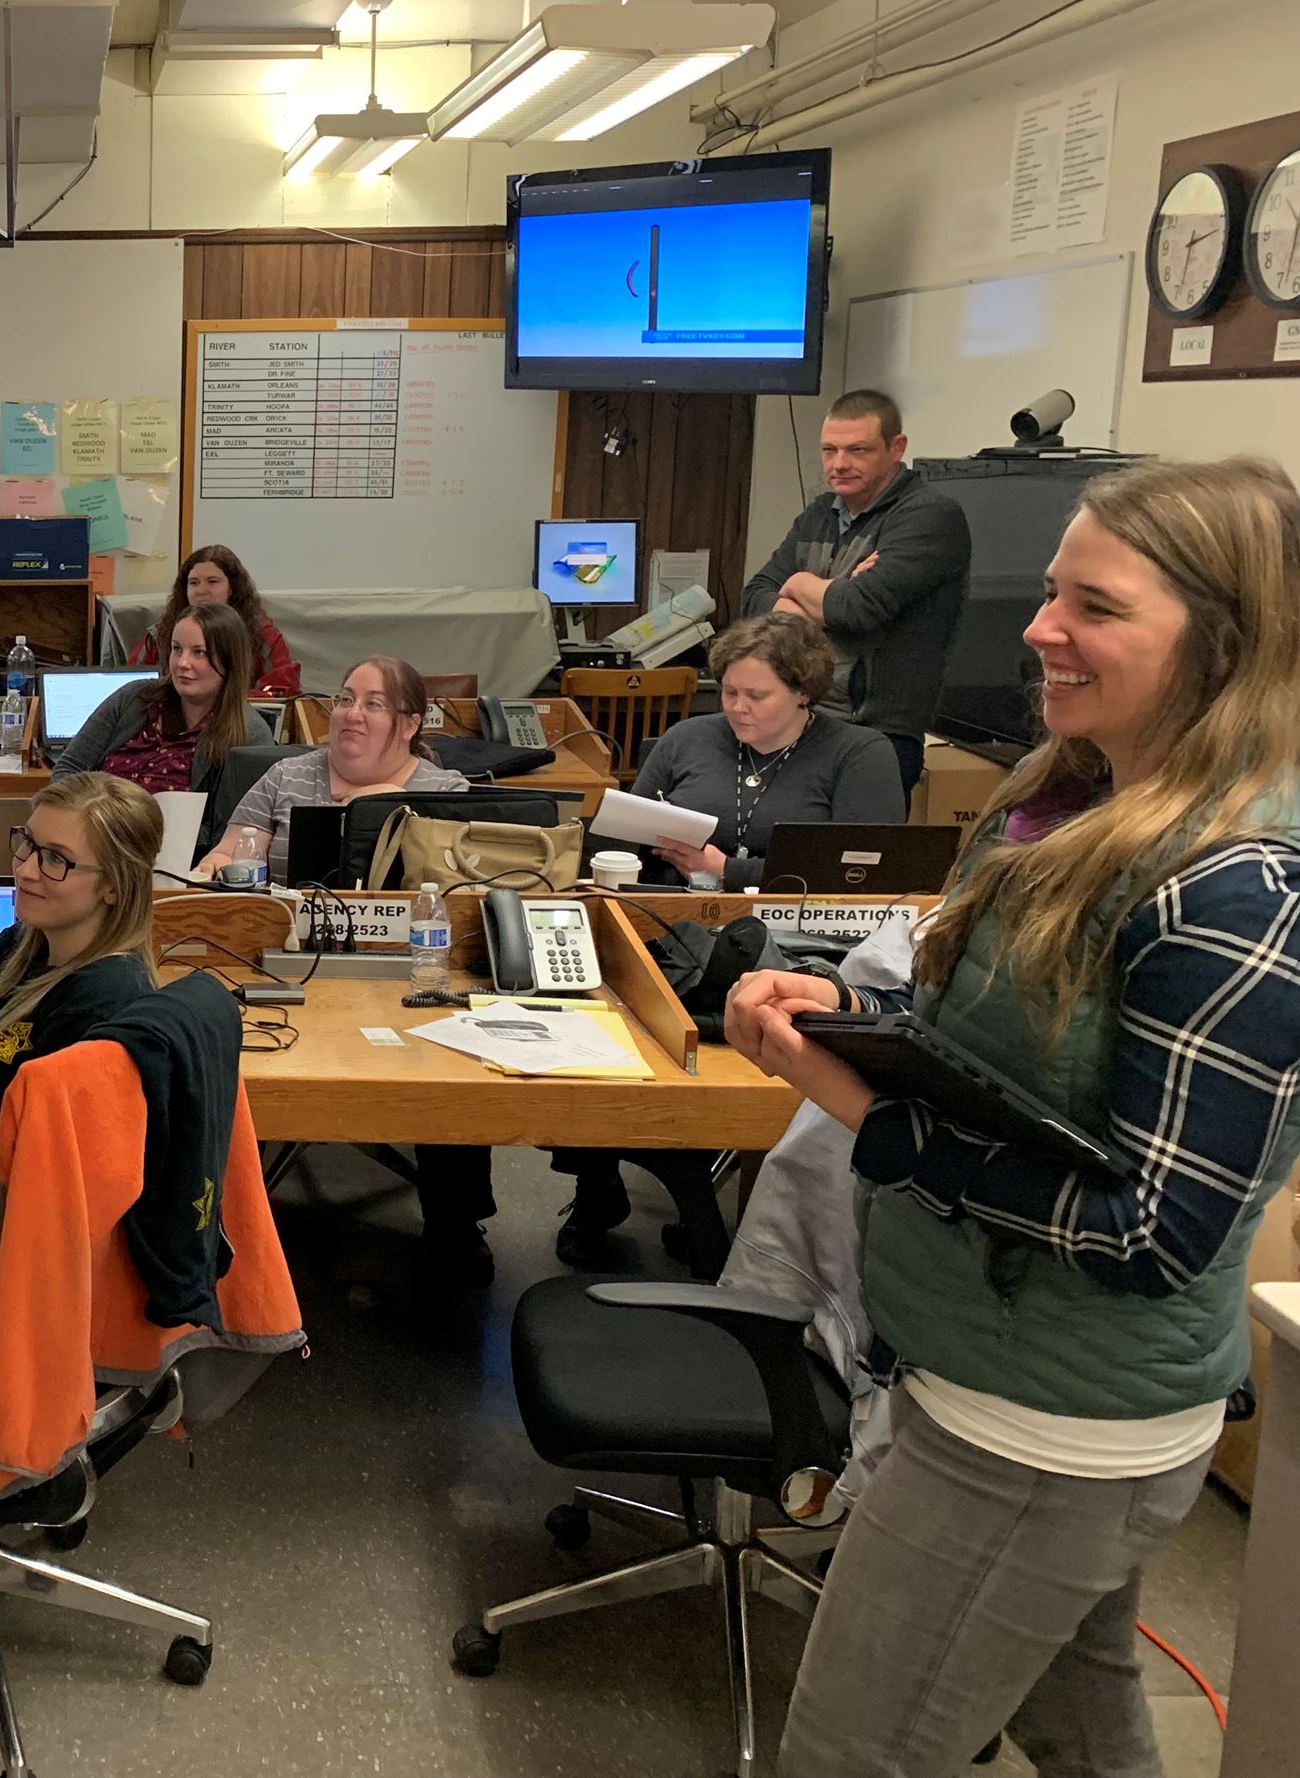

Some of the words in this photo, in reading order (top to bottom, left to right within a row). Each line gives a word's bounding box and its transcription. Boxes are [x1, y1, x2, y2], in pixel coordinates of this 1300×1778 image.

[1269, 193, 1282, 211] 10
[1162, 240, 1169, 257] 9
[1264, 252, 1273, 269] 8
[1164, 267, 1171, 281] 8
[1276, 272, 1285, 289] 7
[1174, 285, 1181, 301] 7
[1187, 288, 1194, 305] 6
[1180, 340, 1206, 351] LOCAL
[12, 560, 41, 568] REFLEX
[374, 905, 406, 917] REP
[760, 909, 795, 920] EOC
